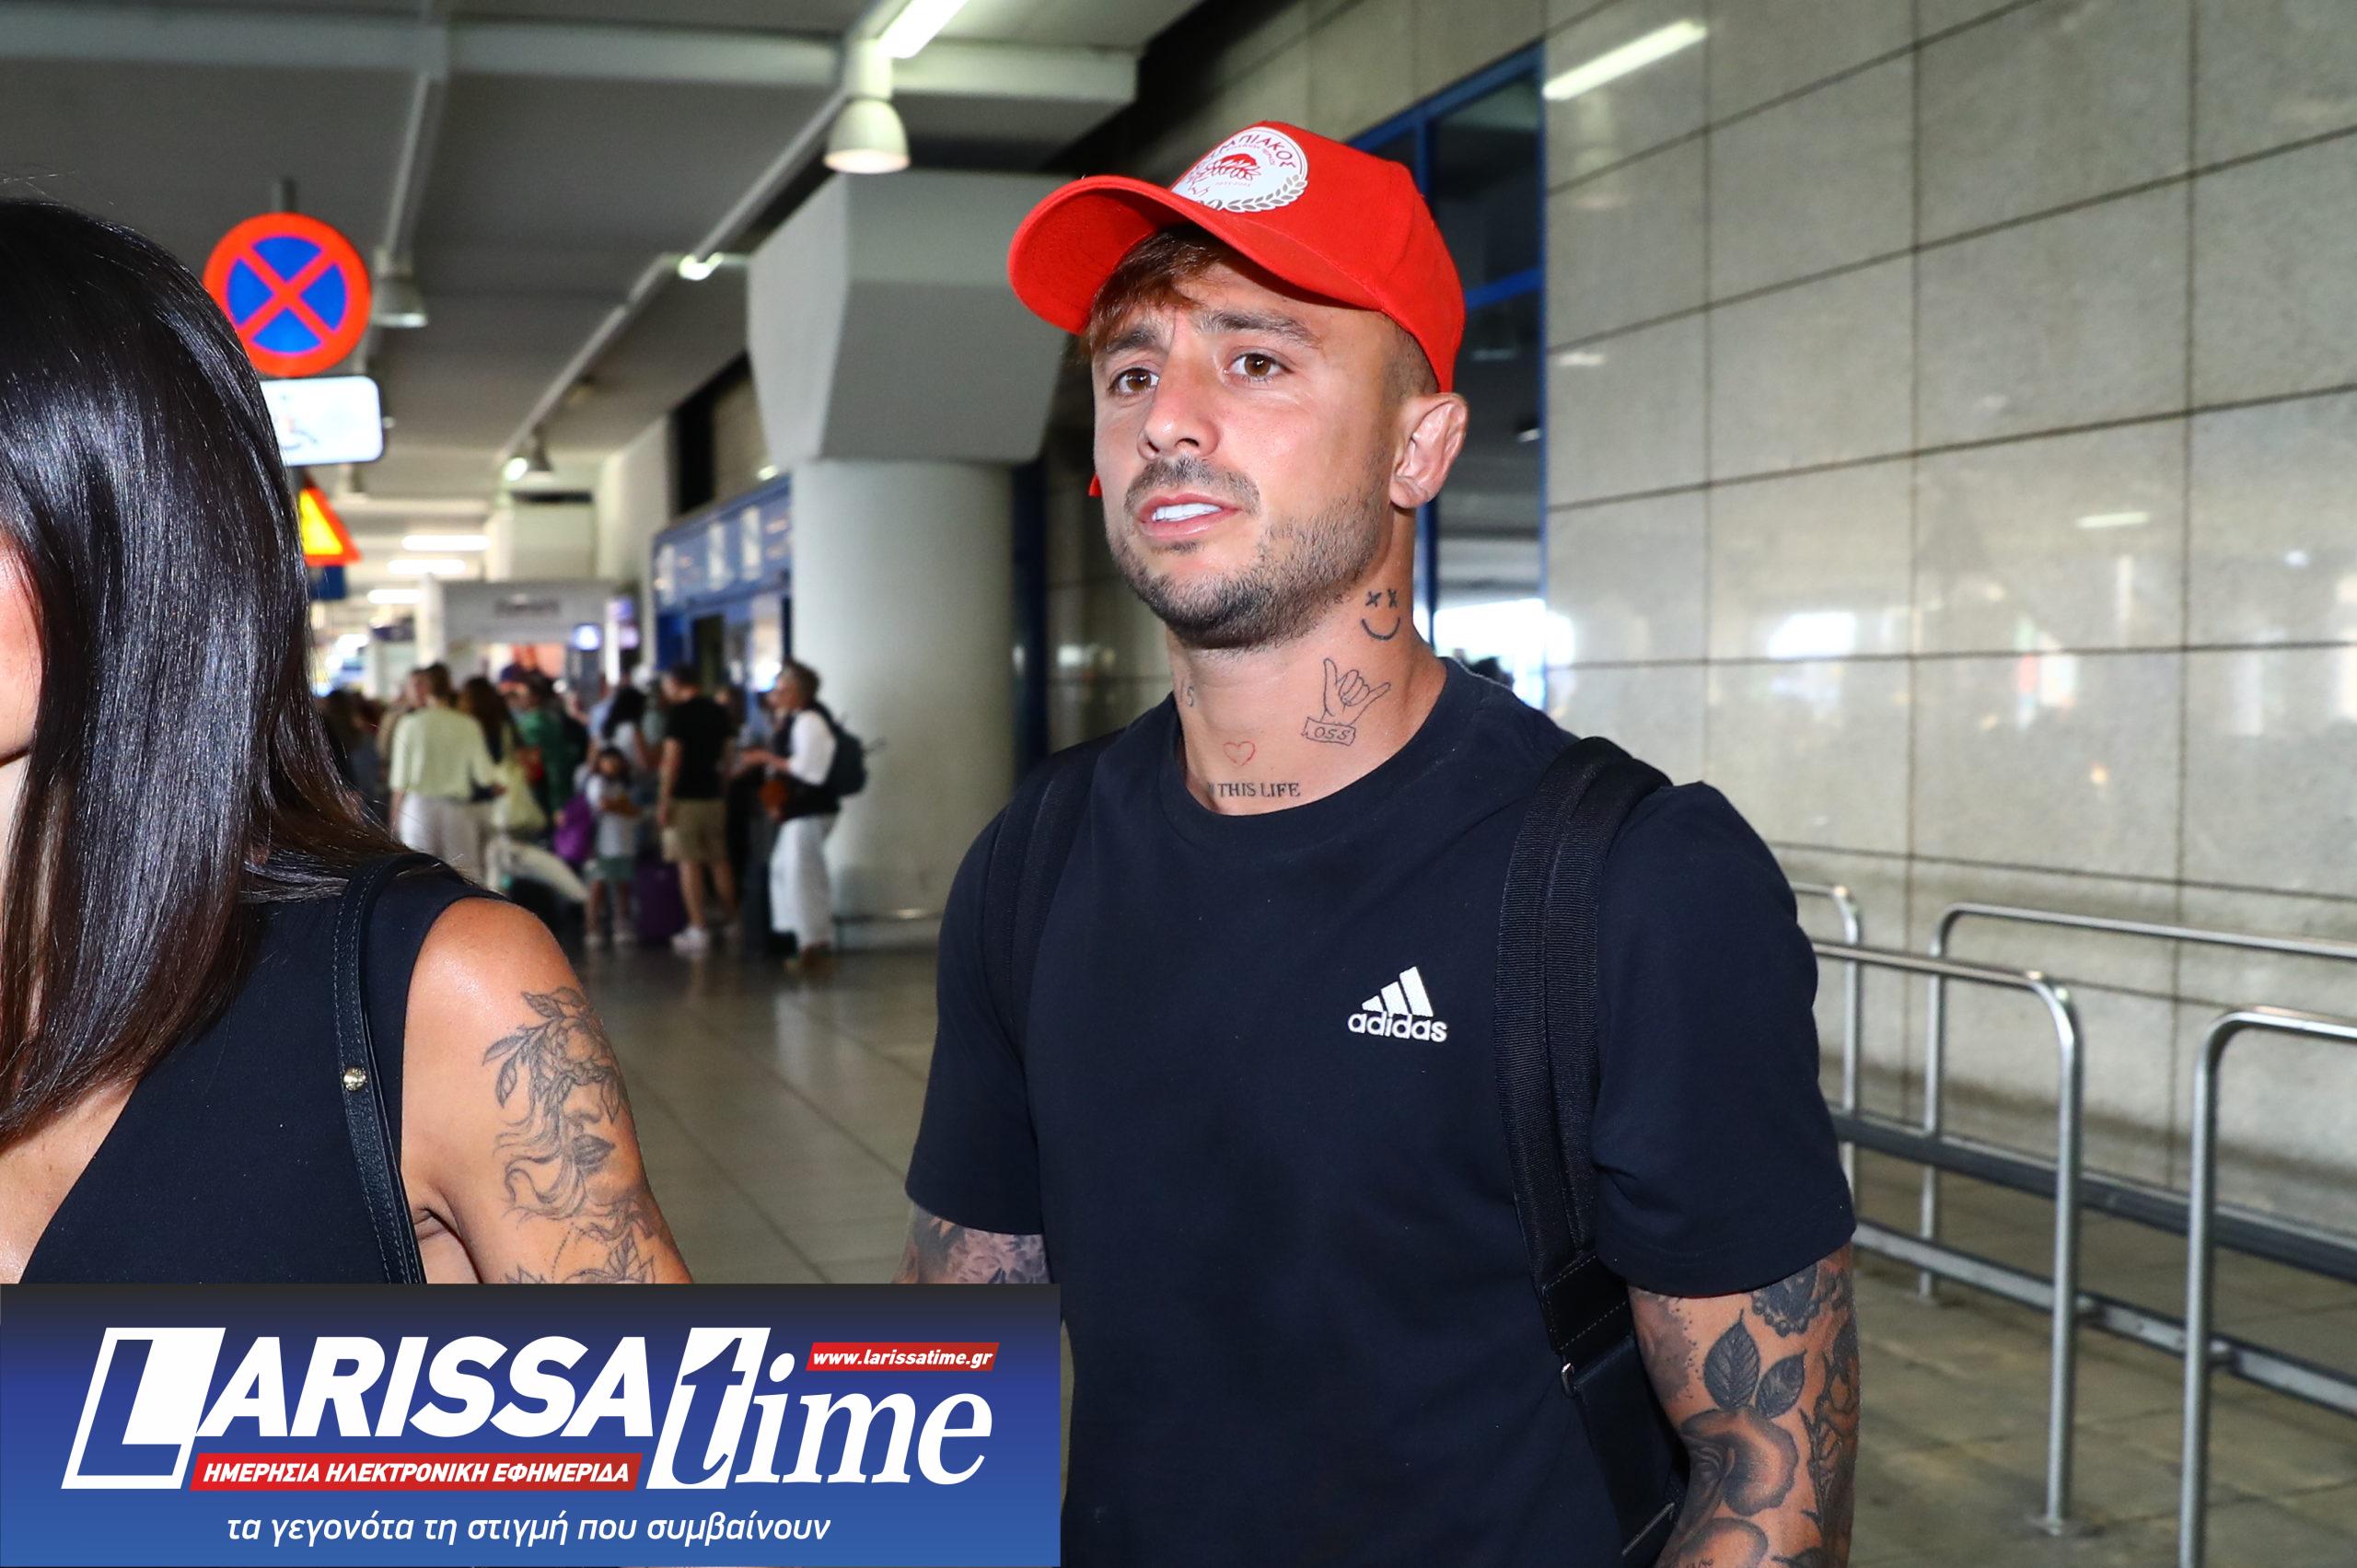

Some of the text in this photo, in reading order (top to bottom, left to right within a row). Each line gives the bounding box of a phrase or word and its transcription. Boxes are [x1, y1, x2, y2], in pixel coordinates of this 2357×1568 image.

[1314, 726, 1352, 740] OSS
[1217, 782, 1257, 798] THIS
[1260, 782, 1301, 798] LIFE
[1347, 1010, 1448, 1043] adidas
